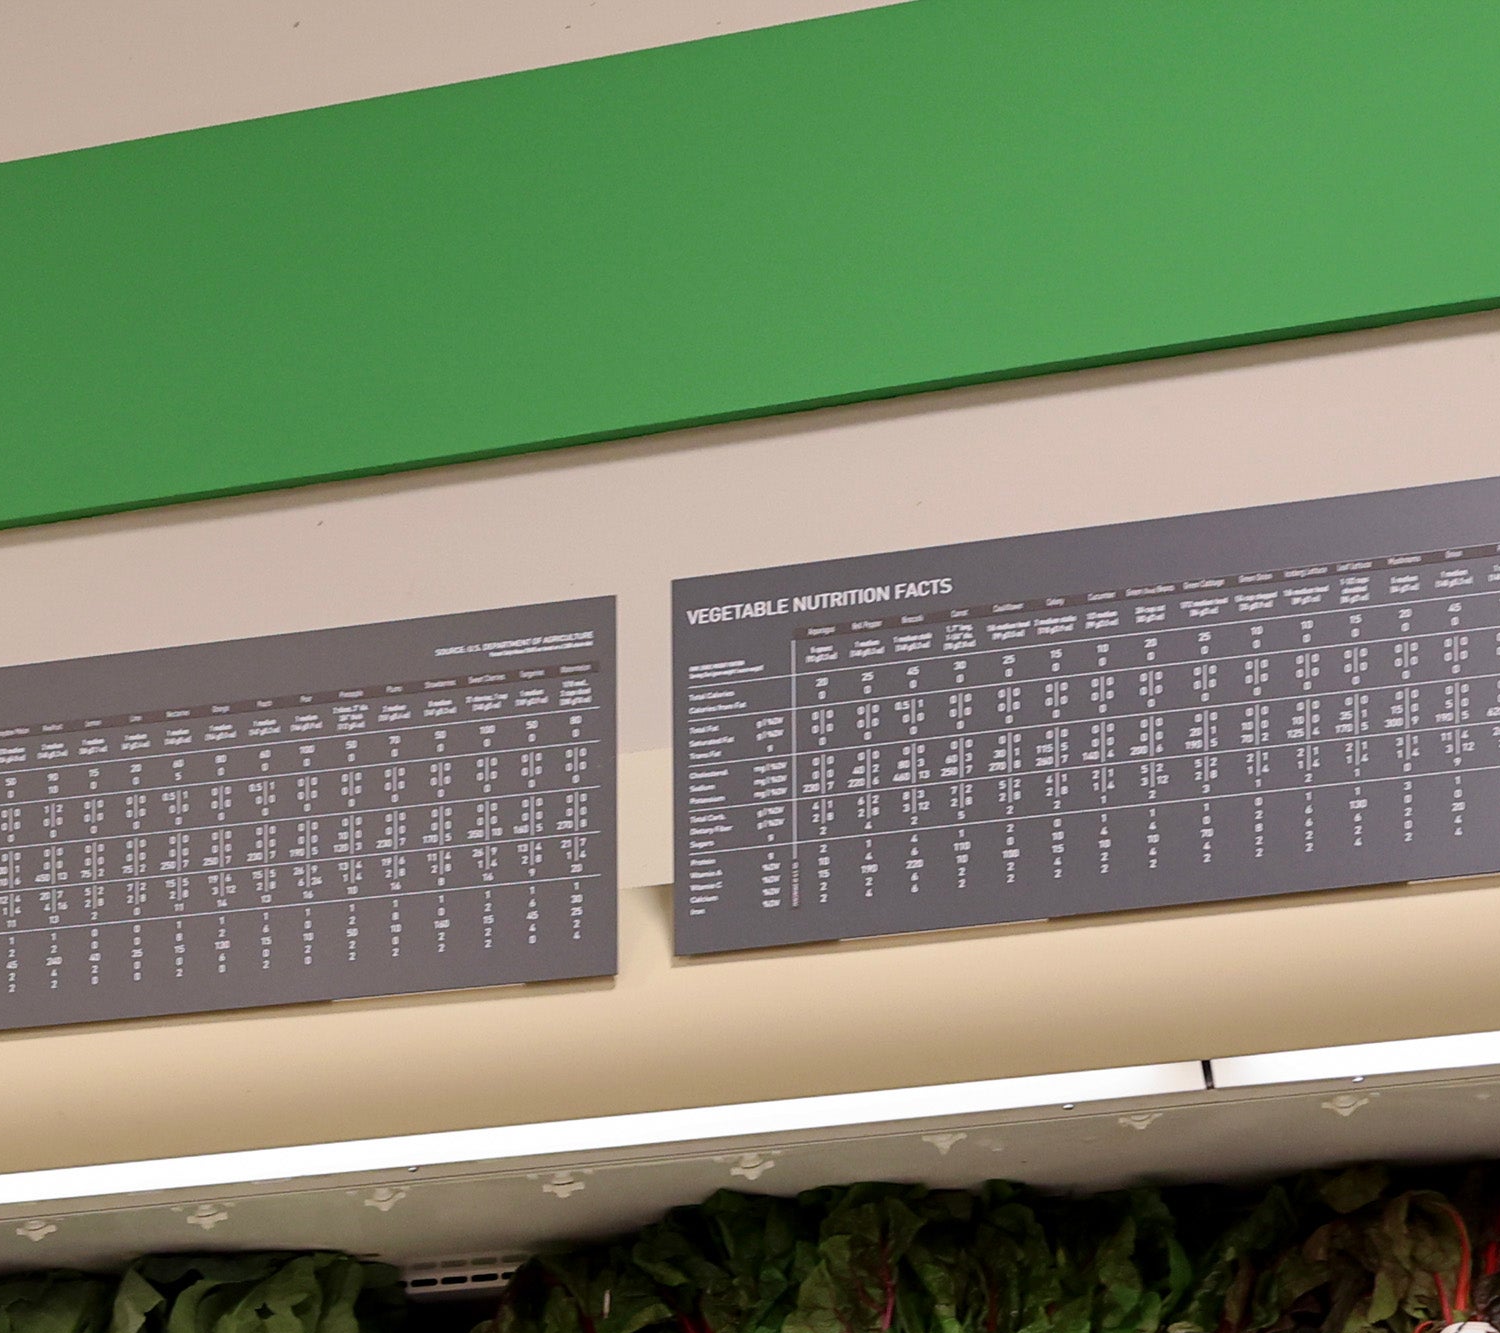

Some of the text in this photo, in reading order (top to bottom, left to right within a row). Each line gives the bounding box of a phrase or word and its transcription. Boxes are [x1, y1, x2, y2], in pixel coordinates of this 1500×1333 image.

[687, 577, 953, 625] VEGETABLE NUTRITION FACTS
